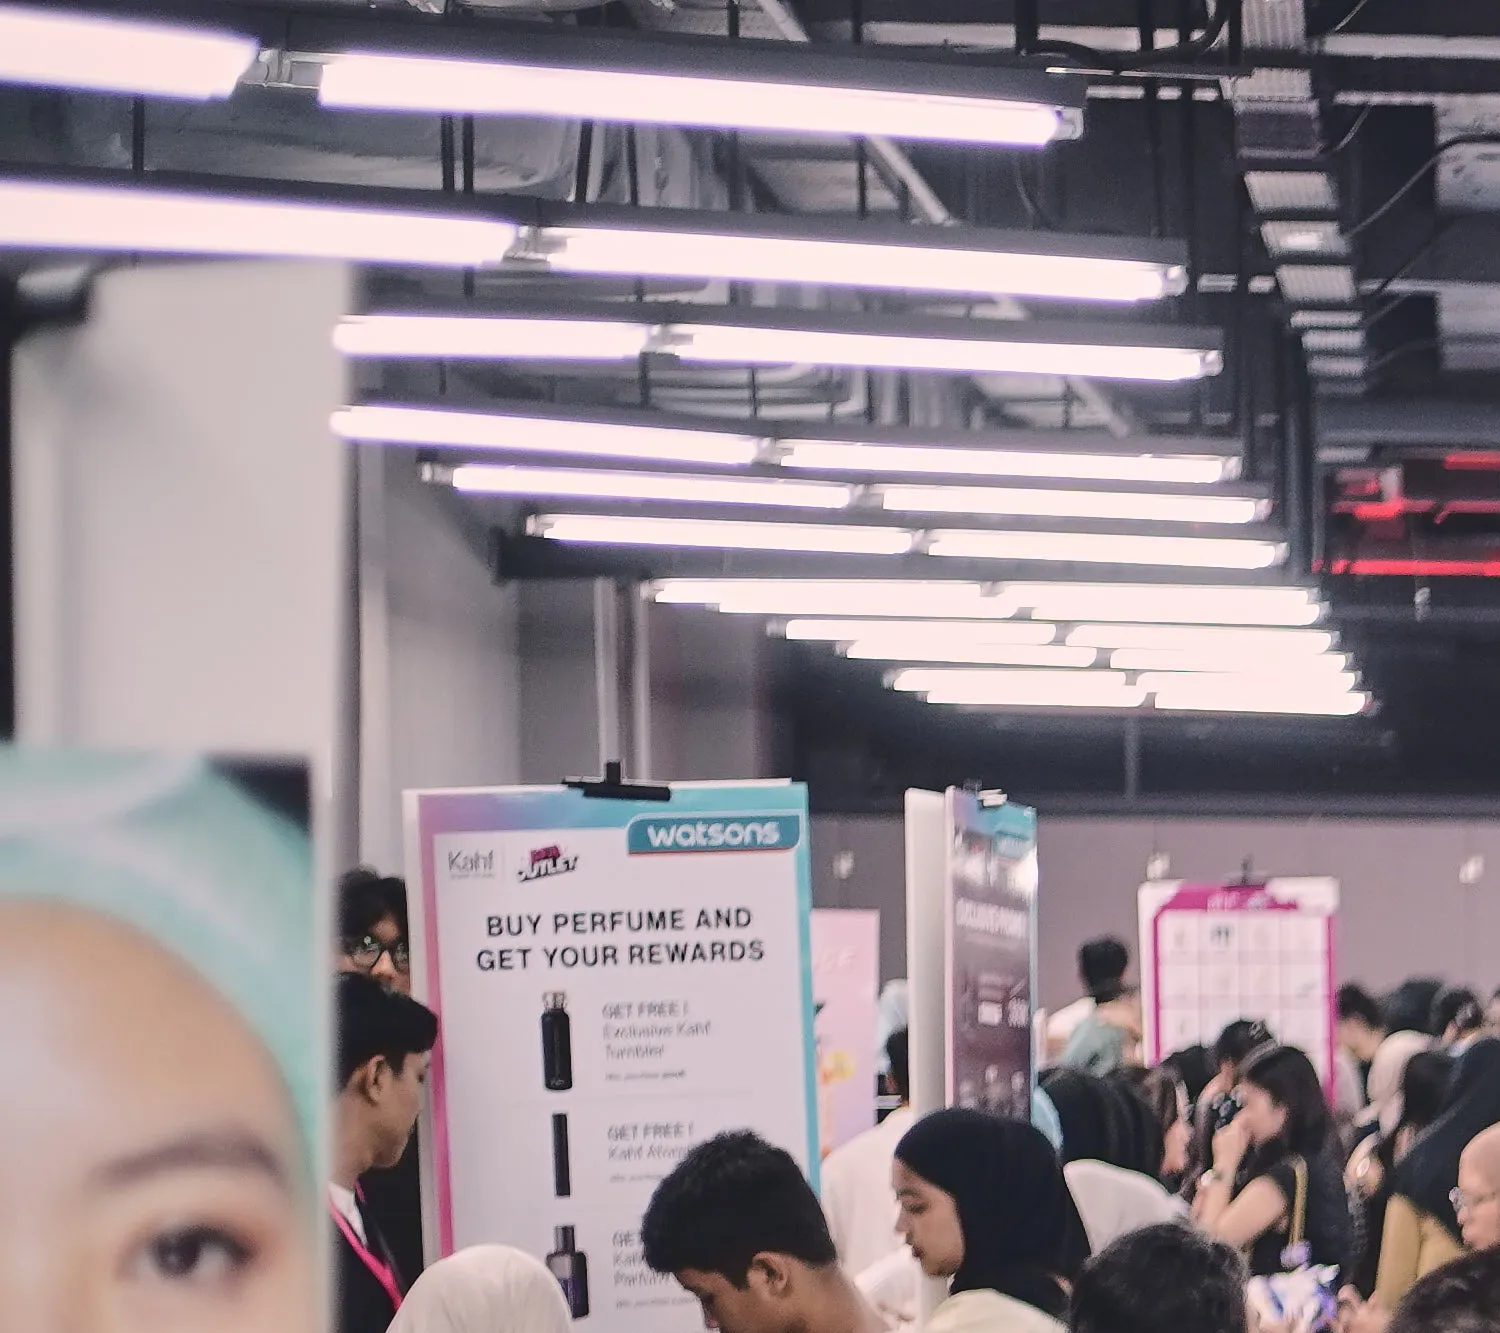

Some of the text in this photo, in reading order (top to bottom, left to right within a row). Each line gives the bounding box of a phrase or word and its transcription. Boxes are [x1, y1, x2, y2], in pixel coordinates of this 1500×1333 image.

[647, 821, 780, 848] watsons
[449, 850, 493, 872] Kahf
[487, 906, 751, 937] BUY PERFUME AND
[477, 938, 765, 971] GET YOUR REWARDS
